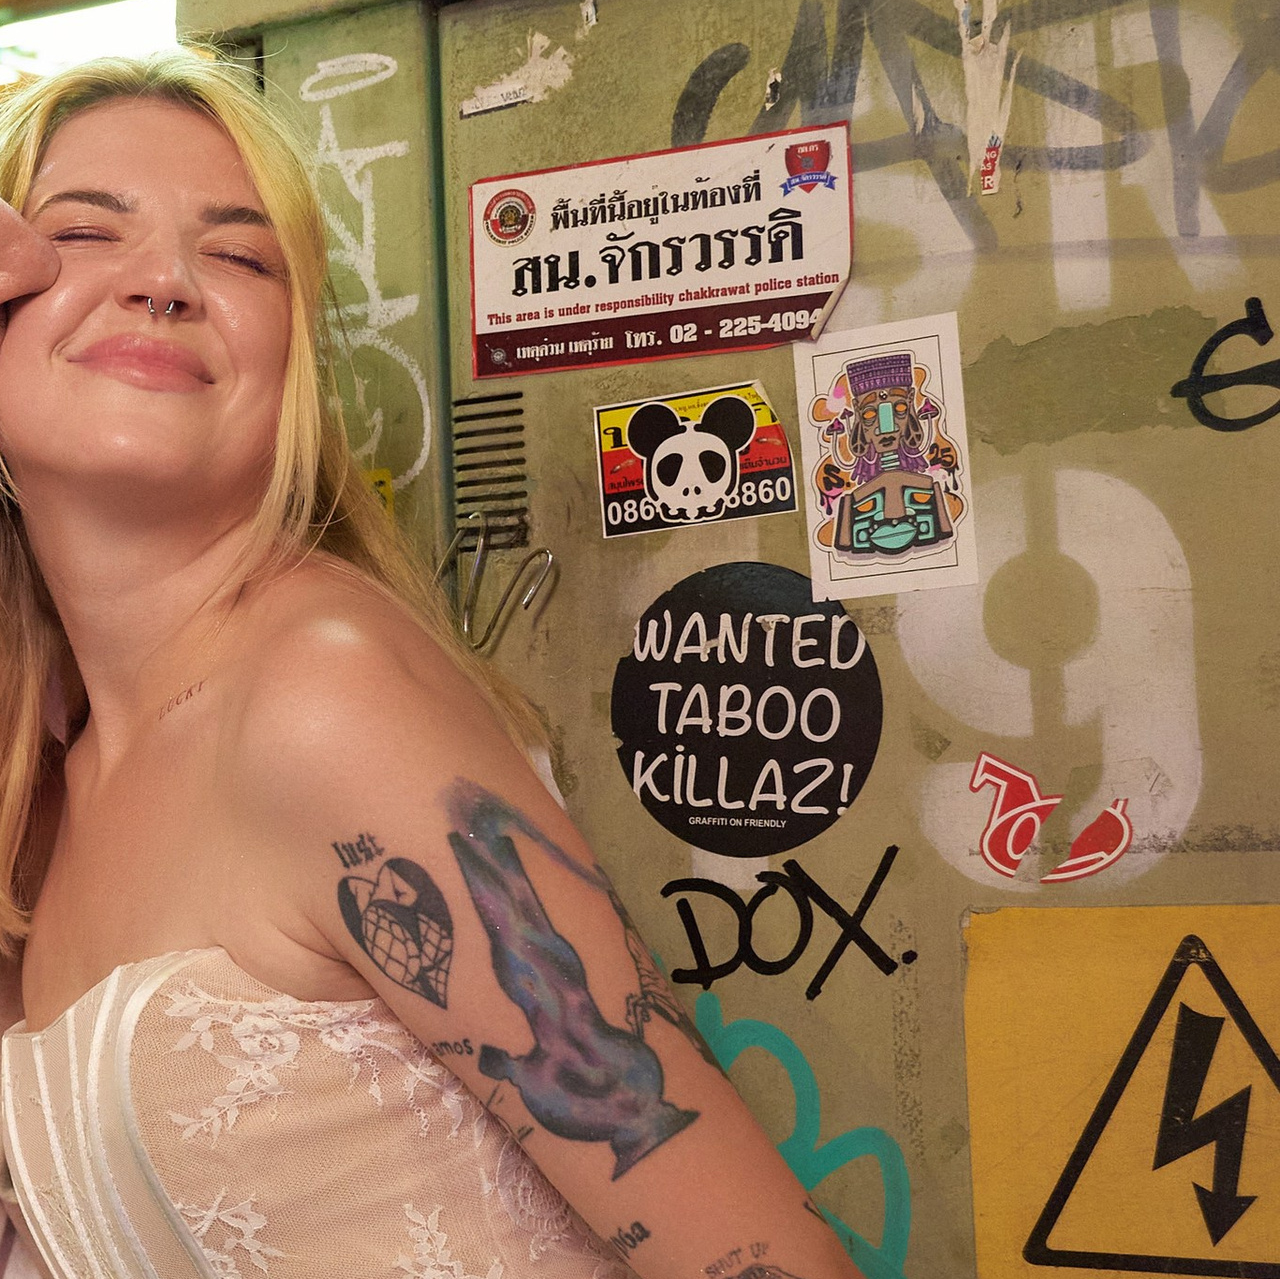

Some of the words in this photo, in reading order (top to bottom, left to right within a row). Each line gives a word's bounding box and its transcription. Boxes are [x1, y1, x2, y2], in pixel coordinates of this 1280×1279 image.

[551, 170, 762, 230] พื้นที่นี้อยู่ในท้องที่
[511, 207, 804, 297] สน.จักรวรรดิ
[487, 313, 512, 326] This
[516, 310, 540, 323] area
[544, 307, 555, 319] is
[558, 303, 591, 317] under
[595, 293, 675, 314] responsibility
[678, 282, 750, 302] chakkrawat
[754, 278, 792, 296] police
[796, 272, 840, 288] station
[516, 337, 565, 362] เหตุด่วน
[568, 331, 614, 356] เหตุร้าย
[624, 329, 663, 350] โทร.
[670, 323, 698, 344] 02
[633, 608, 867, 670] WANTED
[649, 682, 841, 743] TABOO
[688, 816, 728, 826] GRAFFITI
[729, 817, 742, 827] ON
[744, 818, 787, 829] FRIENDLY
